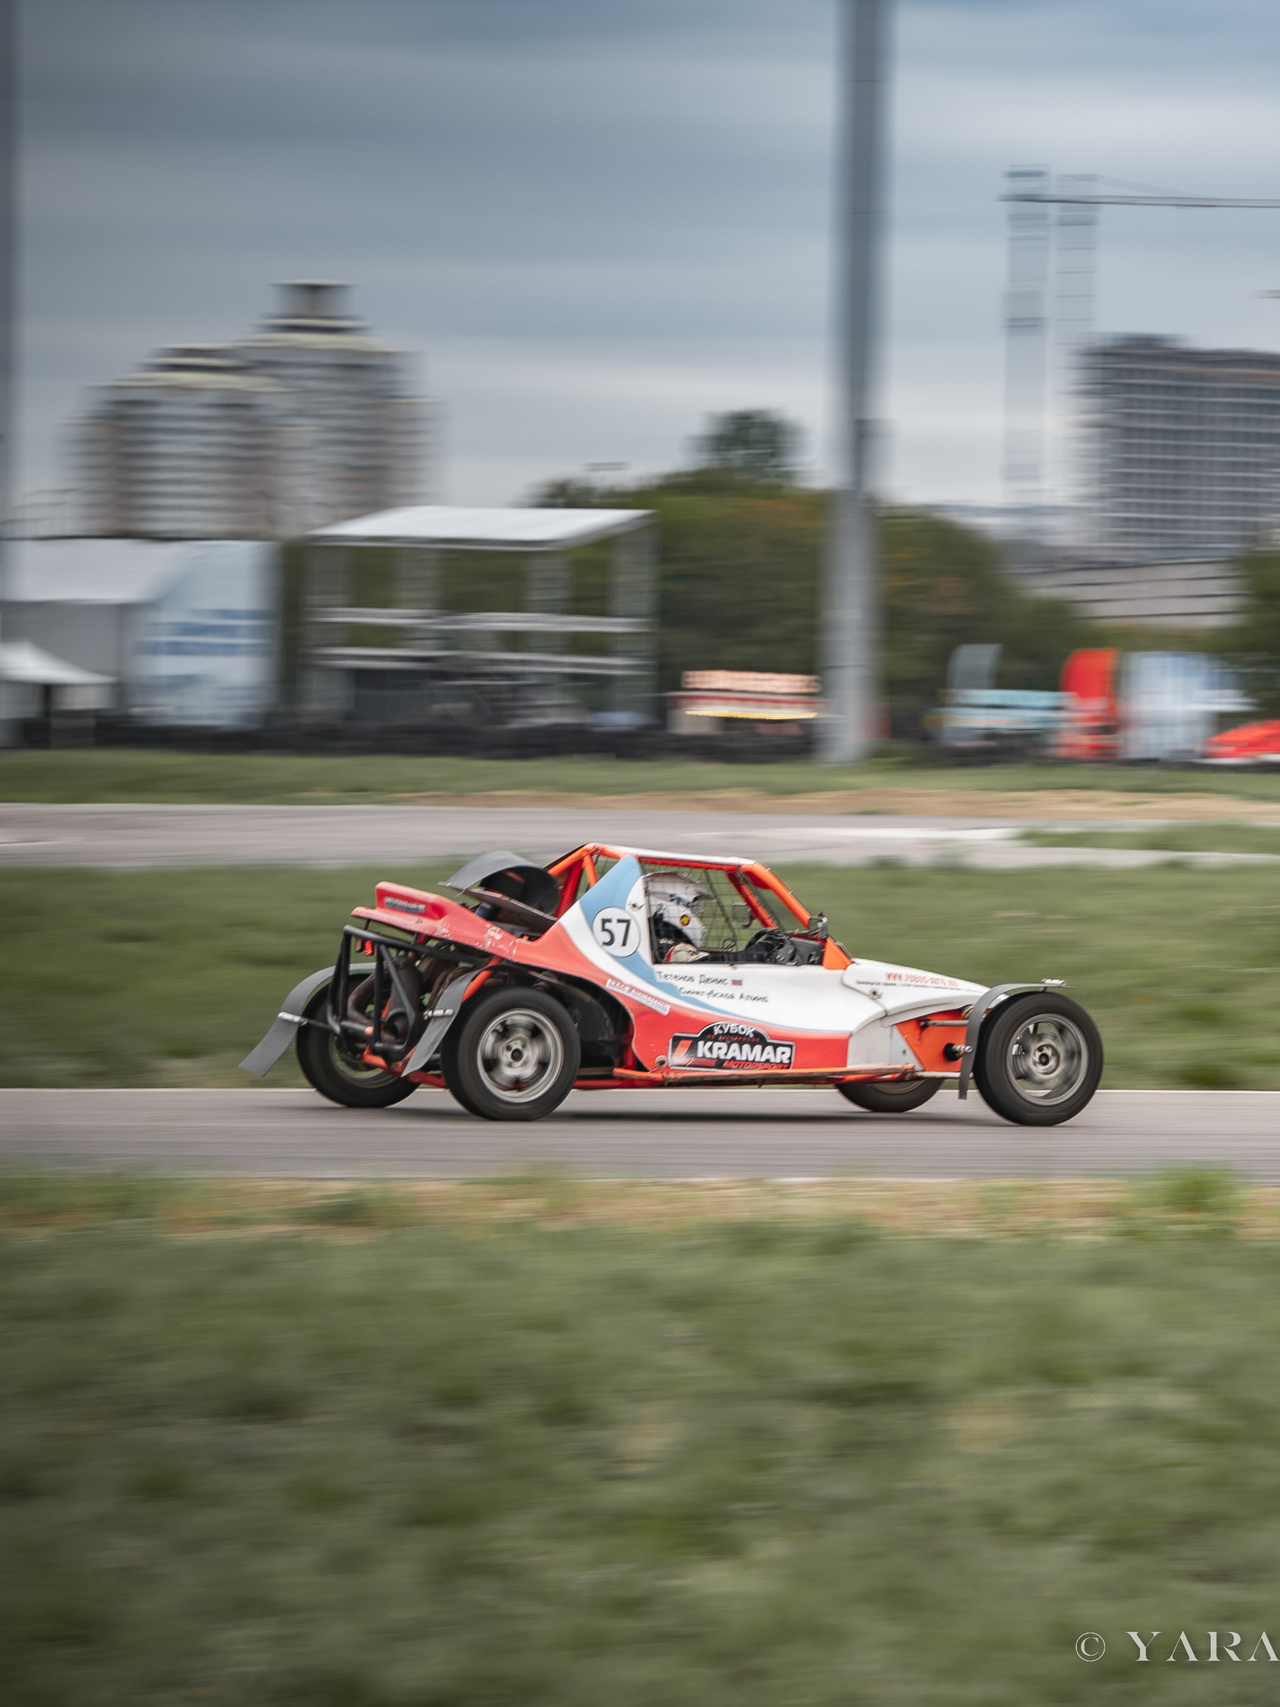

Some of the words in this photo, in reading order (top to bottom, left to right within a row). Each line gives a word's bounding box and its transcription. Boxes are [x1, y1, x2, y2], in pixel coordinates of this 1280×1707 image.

[600, 917, 632, 948] 57
[712, 1022, 756, 1039] КУБОК
[696, 1040, 792, 1063] KRAMAR
[722, 1059, 790, 1070] MOTORSPORT
